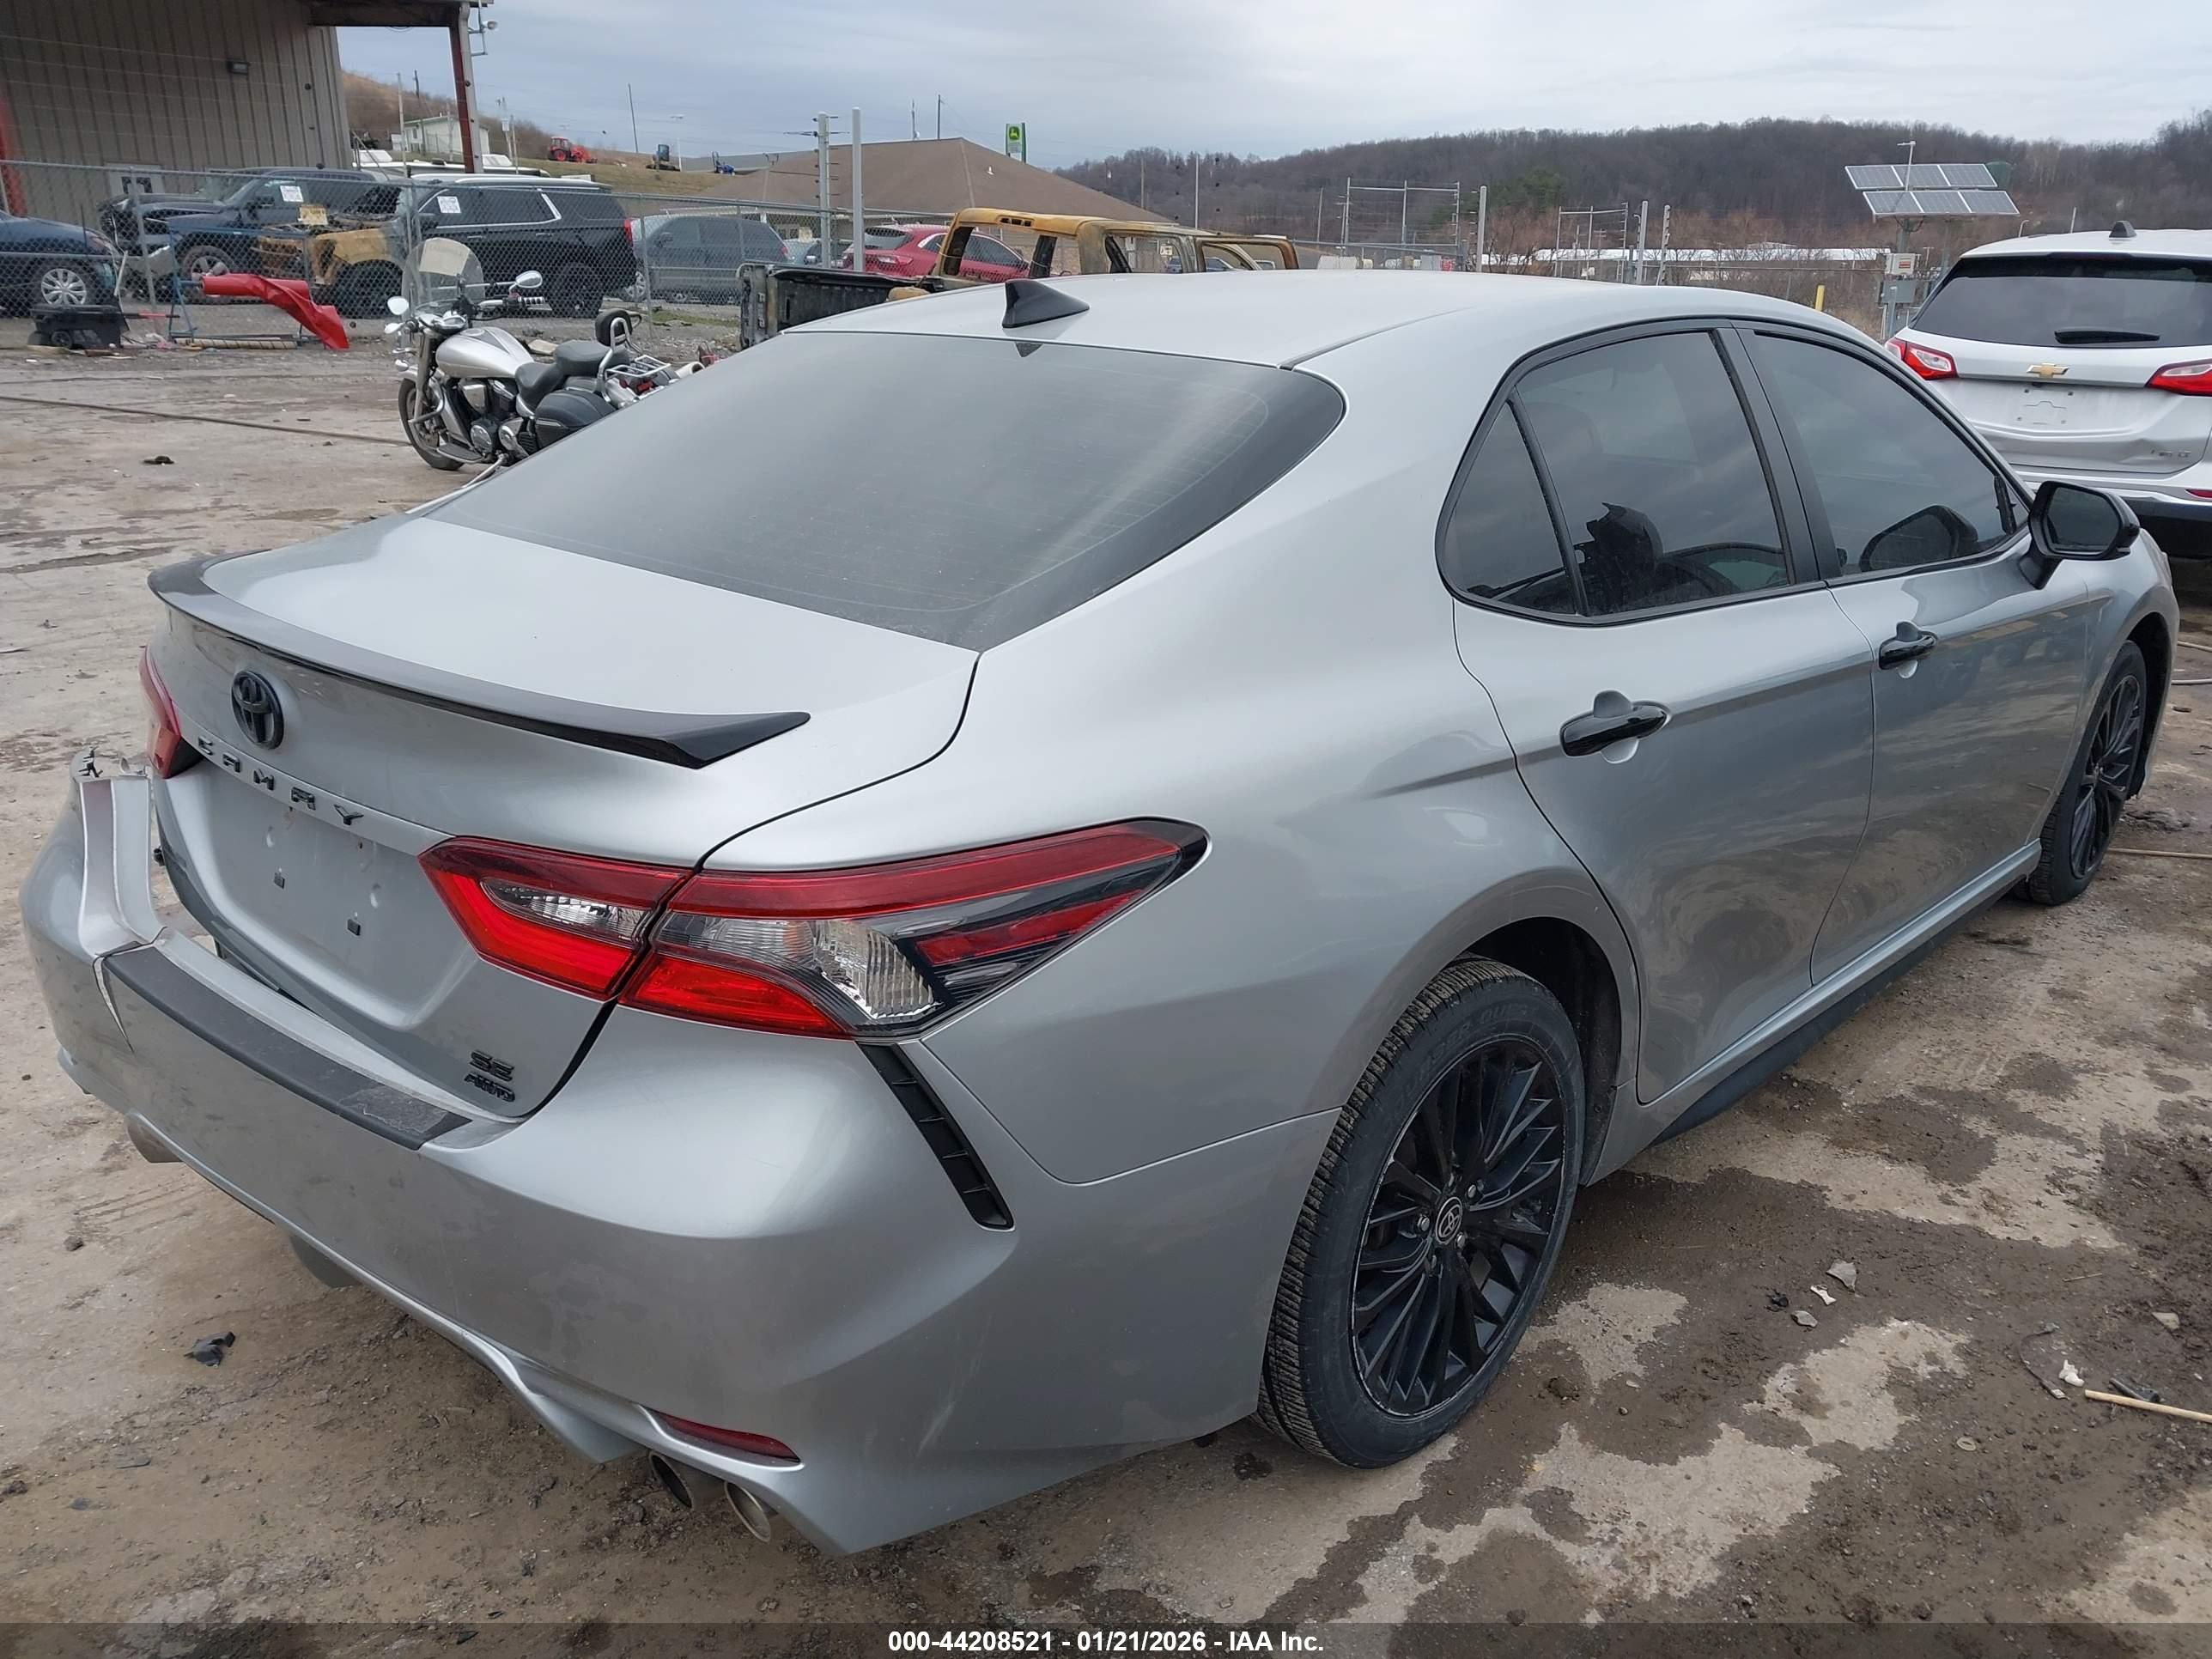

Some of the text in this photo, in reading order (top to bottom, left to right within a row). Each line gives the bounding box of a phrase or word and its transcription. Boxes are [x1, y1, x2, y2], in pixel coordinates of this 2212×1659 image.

[198, 736, 365, 826] CAMRY
[470, 1050, 514, 1081] SE
[464, 1073, 515, 1103] AWD
